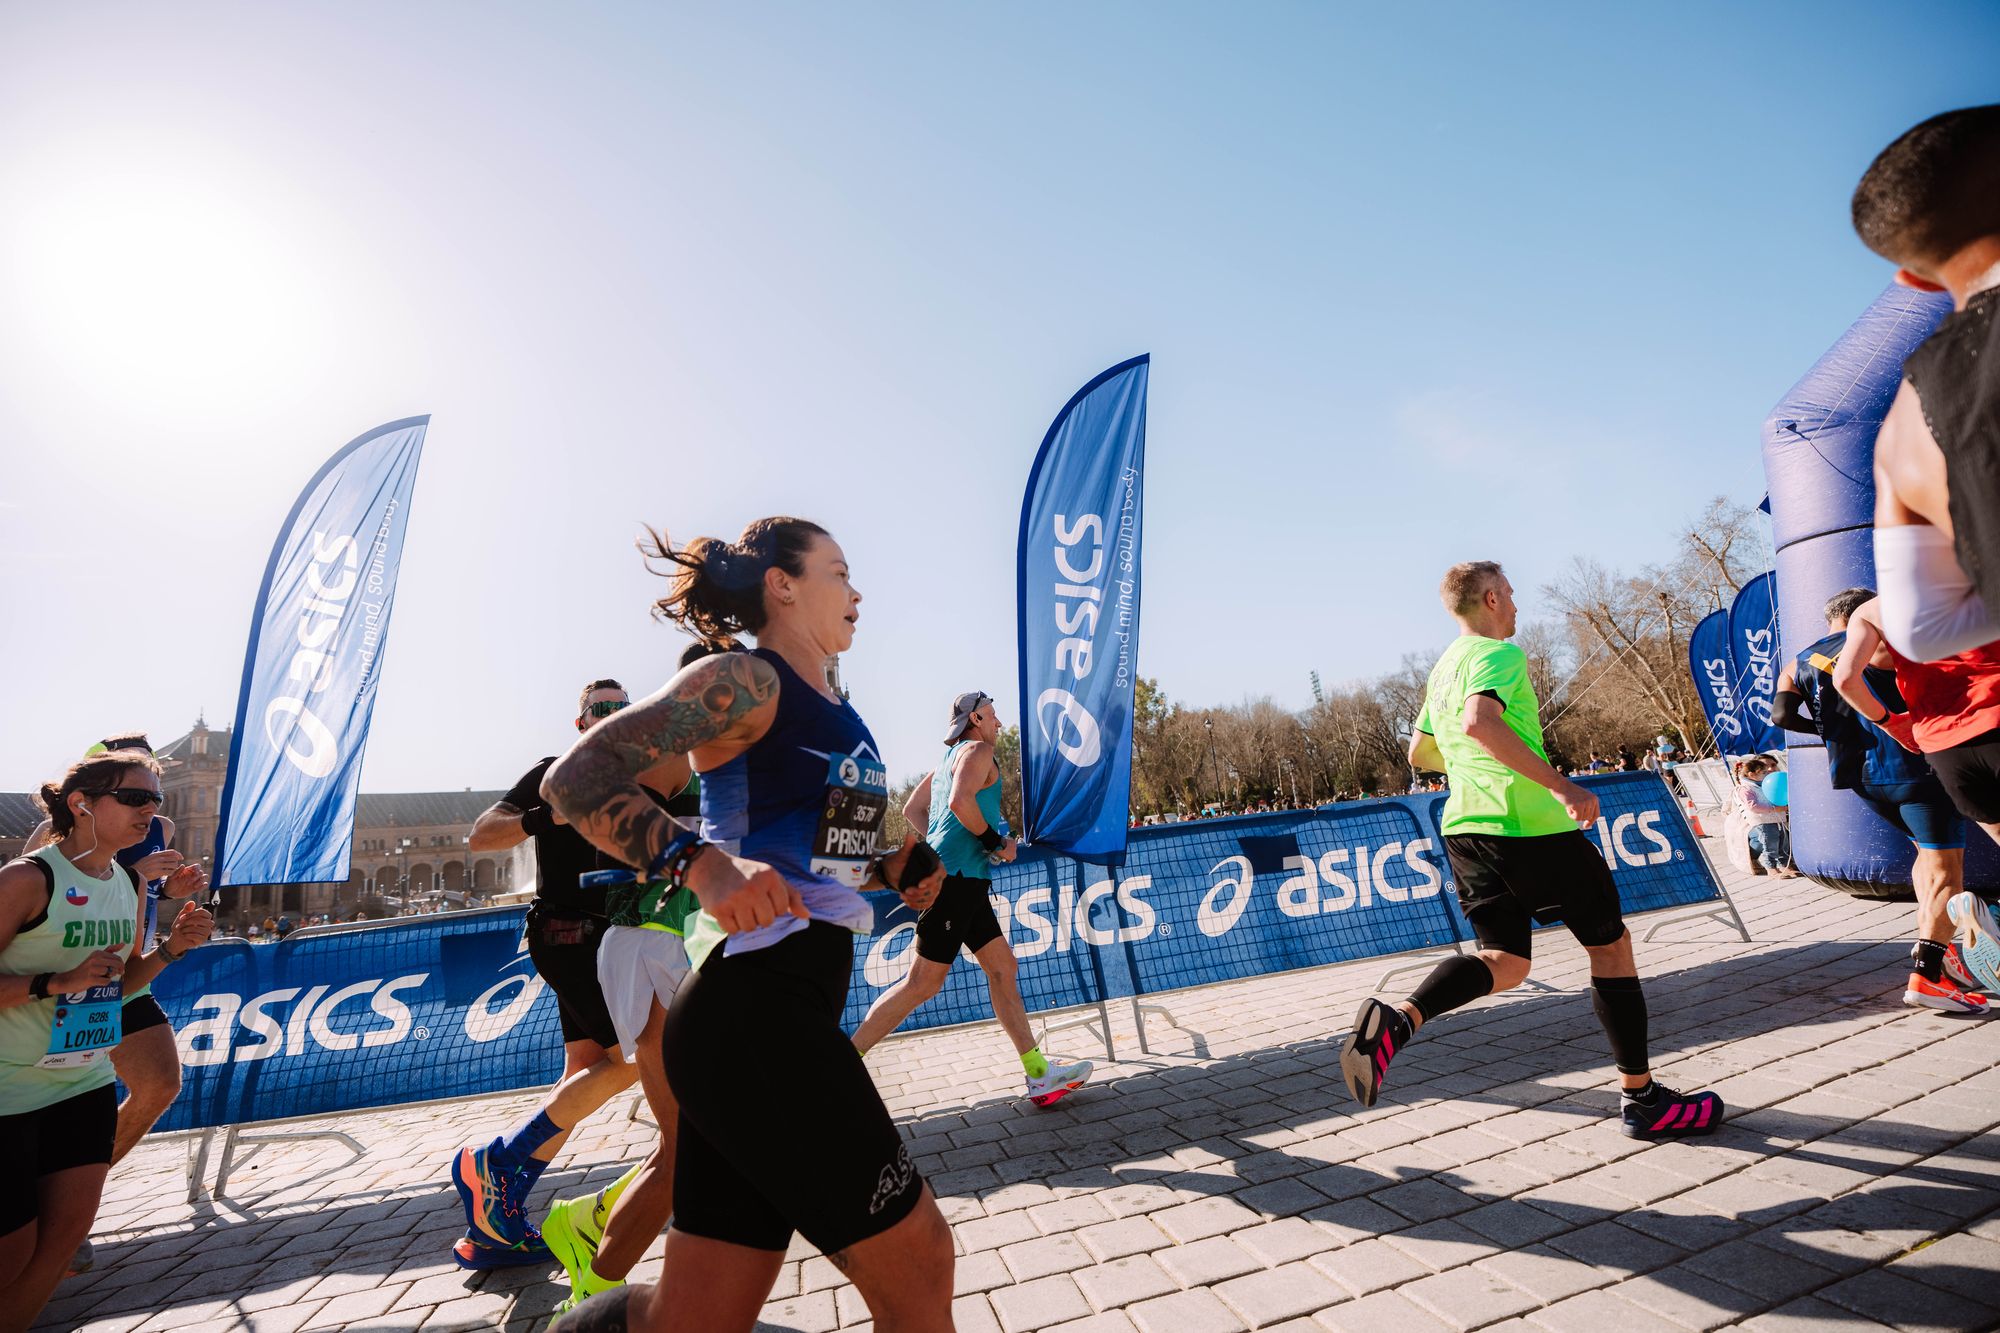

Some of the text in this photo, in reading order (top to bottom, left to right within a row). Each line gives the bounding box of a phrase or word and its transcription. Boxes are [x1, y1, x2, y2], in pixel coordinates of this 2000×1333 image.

[290, 531, 358, 693] asics
[355, 498, 399, 704] sound mind, sound body
[1054, 513, 1103, 680] asics
[1115, 466, 1139, 688] sound mind, sound body
[1703, 658, 1735, 711] asics
[1745, 629, 1774, 695] asics
[863, 768, 887, 788] ZUR
[1277, 838, 1442, 917] asics
[1580, 810, 1672, 870] ics
[64, 1026, 115, 1049] LOYOLA
[175, 972, 430, 1067] asics
